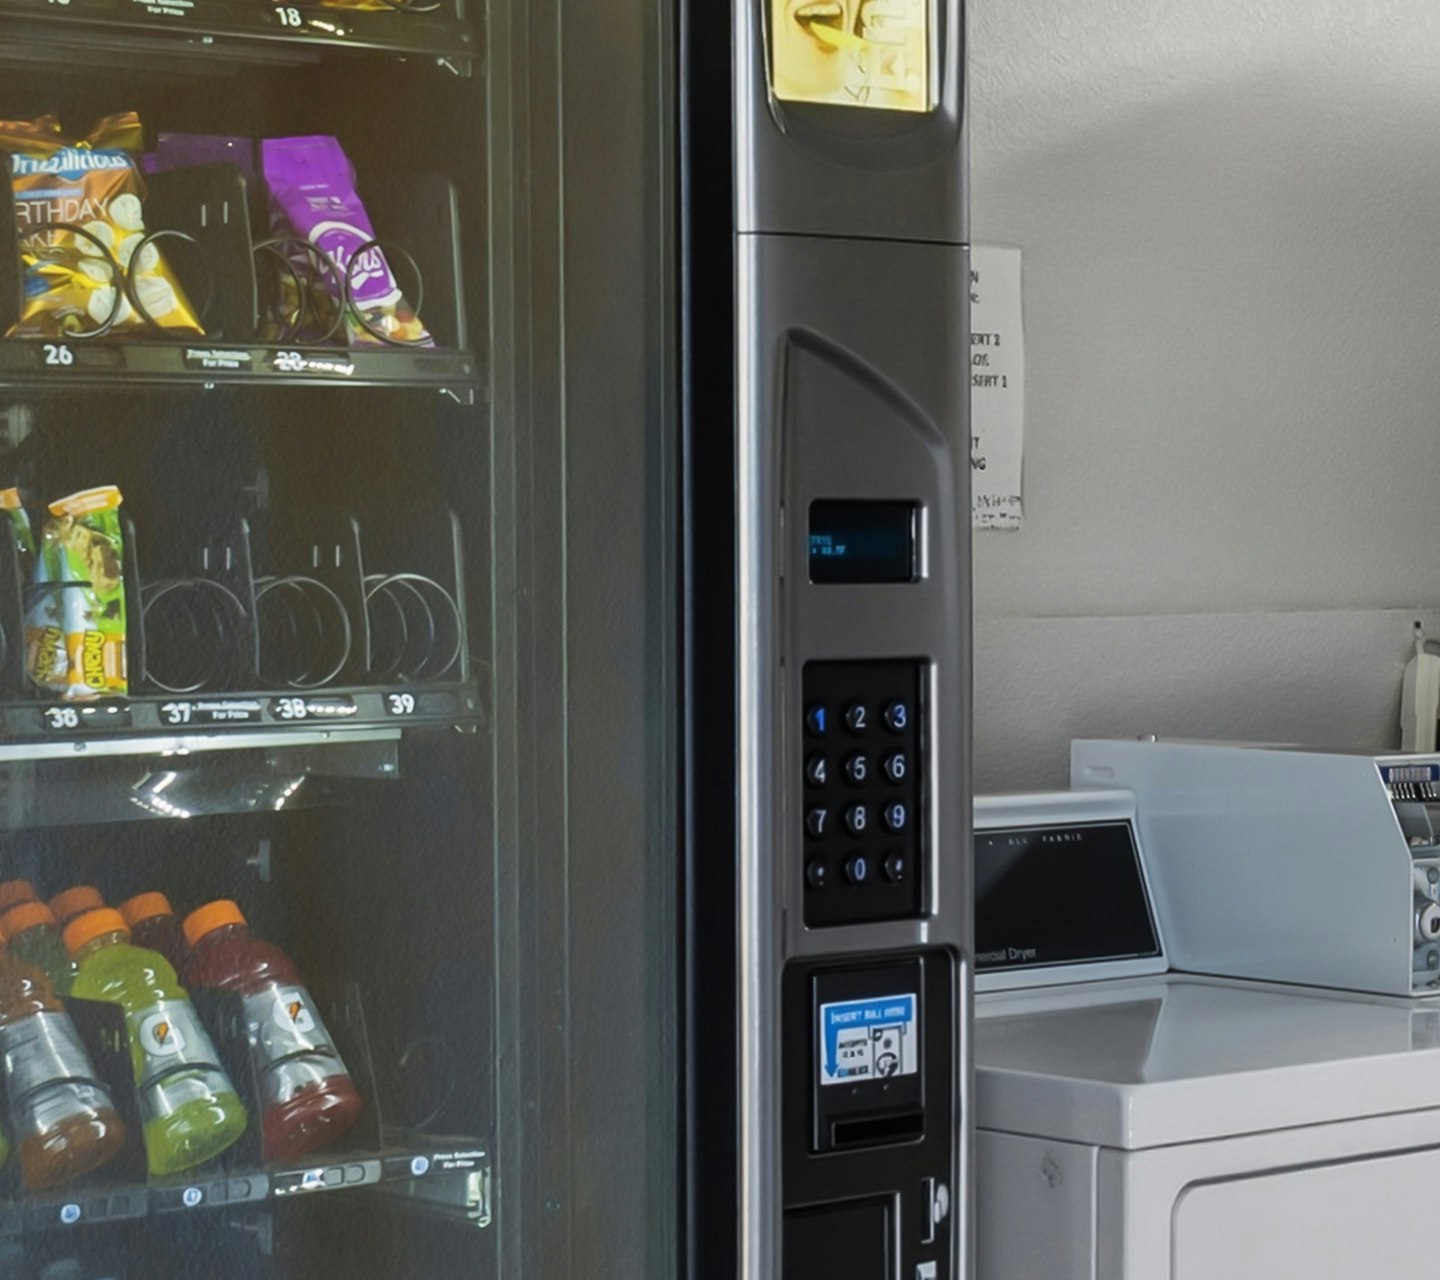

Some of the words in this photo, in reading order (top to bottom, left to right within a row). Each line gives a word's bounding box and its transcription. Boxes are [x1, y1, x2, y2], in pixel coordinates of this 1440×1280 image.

[275, 7, 302, 26] 18
[44, 344, 73, 365] 26
[166, 701, 191, 723] 37
[278, 698, 307, 719] 38
[389, 693, 415, 714] 39
[50, 707, 79, 728] 36
[815, 707, 825, 731] 1
[854, 706, 866, 728] 2
[893, 704, 907, 728] 3
[814, 759, 826, 783] 4
[854, 756, 866, 780] 5
[892, 754, 905, 778] 6
[814, 809, 827, 833] 7
[854, 806, 866, 830] 8
[892, 804, 905, 828] 9
[854, 858, 866, 881] 0
[1008, 947, 1037, 962] Dryer
